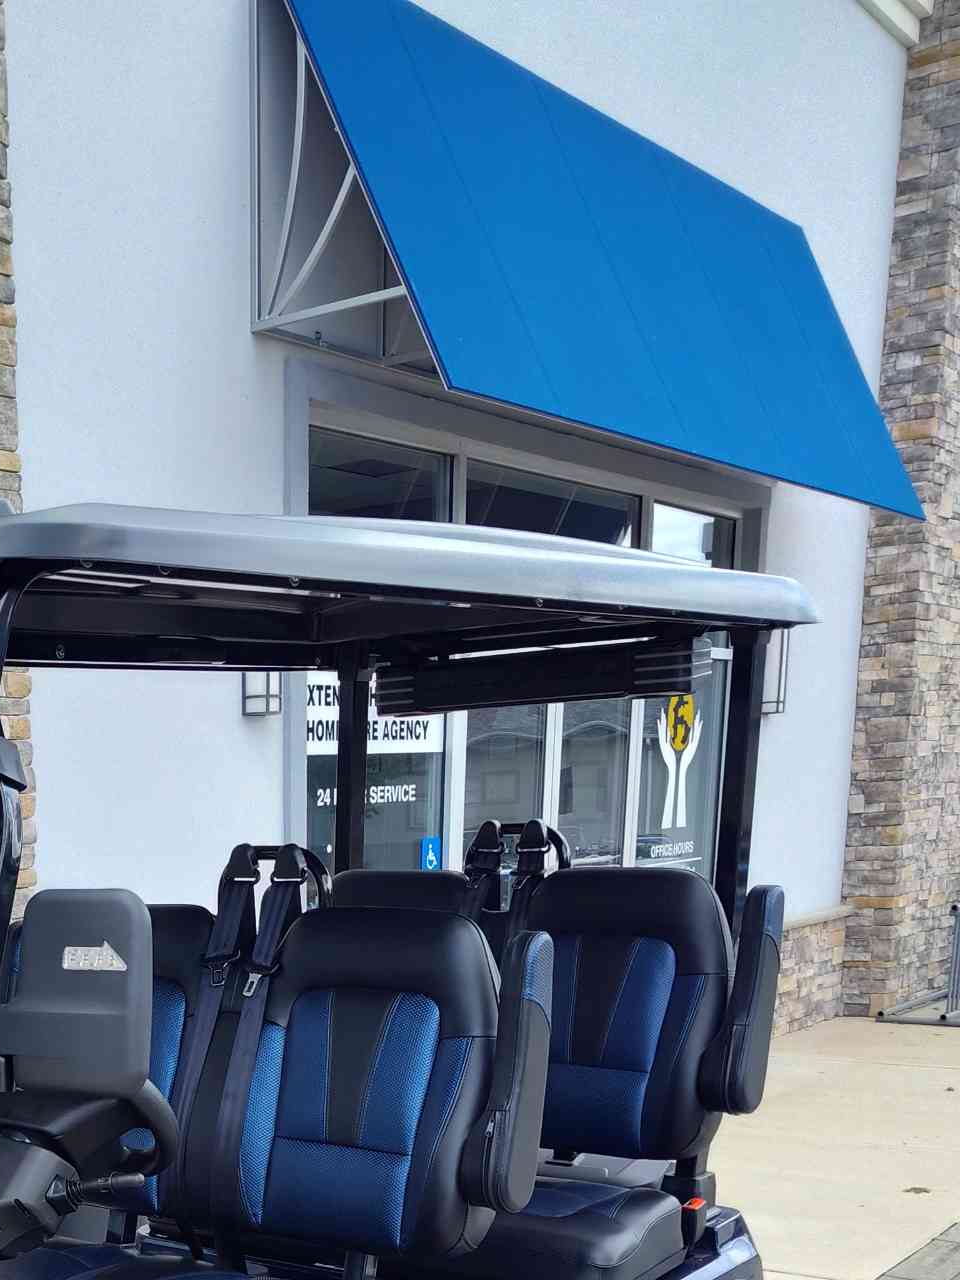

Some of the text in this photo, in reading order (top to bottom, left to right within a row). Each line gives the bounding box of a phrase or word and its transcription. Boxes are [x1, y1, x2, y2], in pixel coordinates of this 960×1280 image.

[382, 720, 429, 740] AGENCY
[317, 788, 331, 806] 24
[369, 785, 416, 803] SERVICE
[650, 840, 695, 858] OFFICE HOURS
